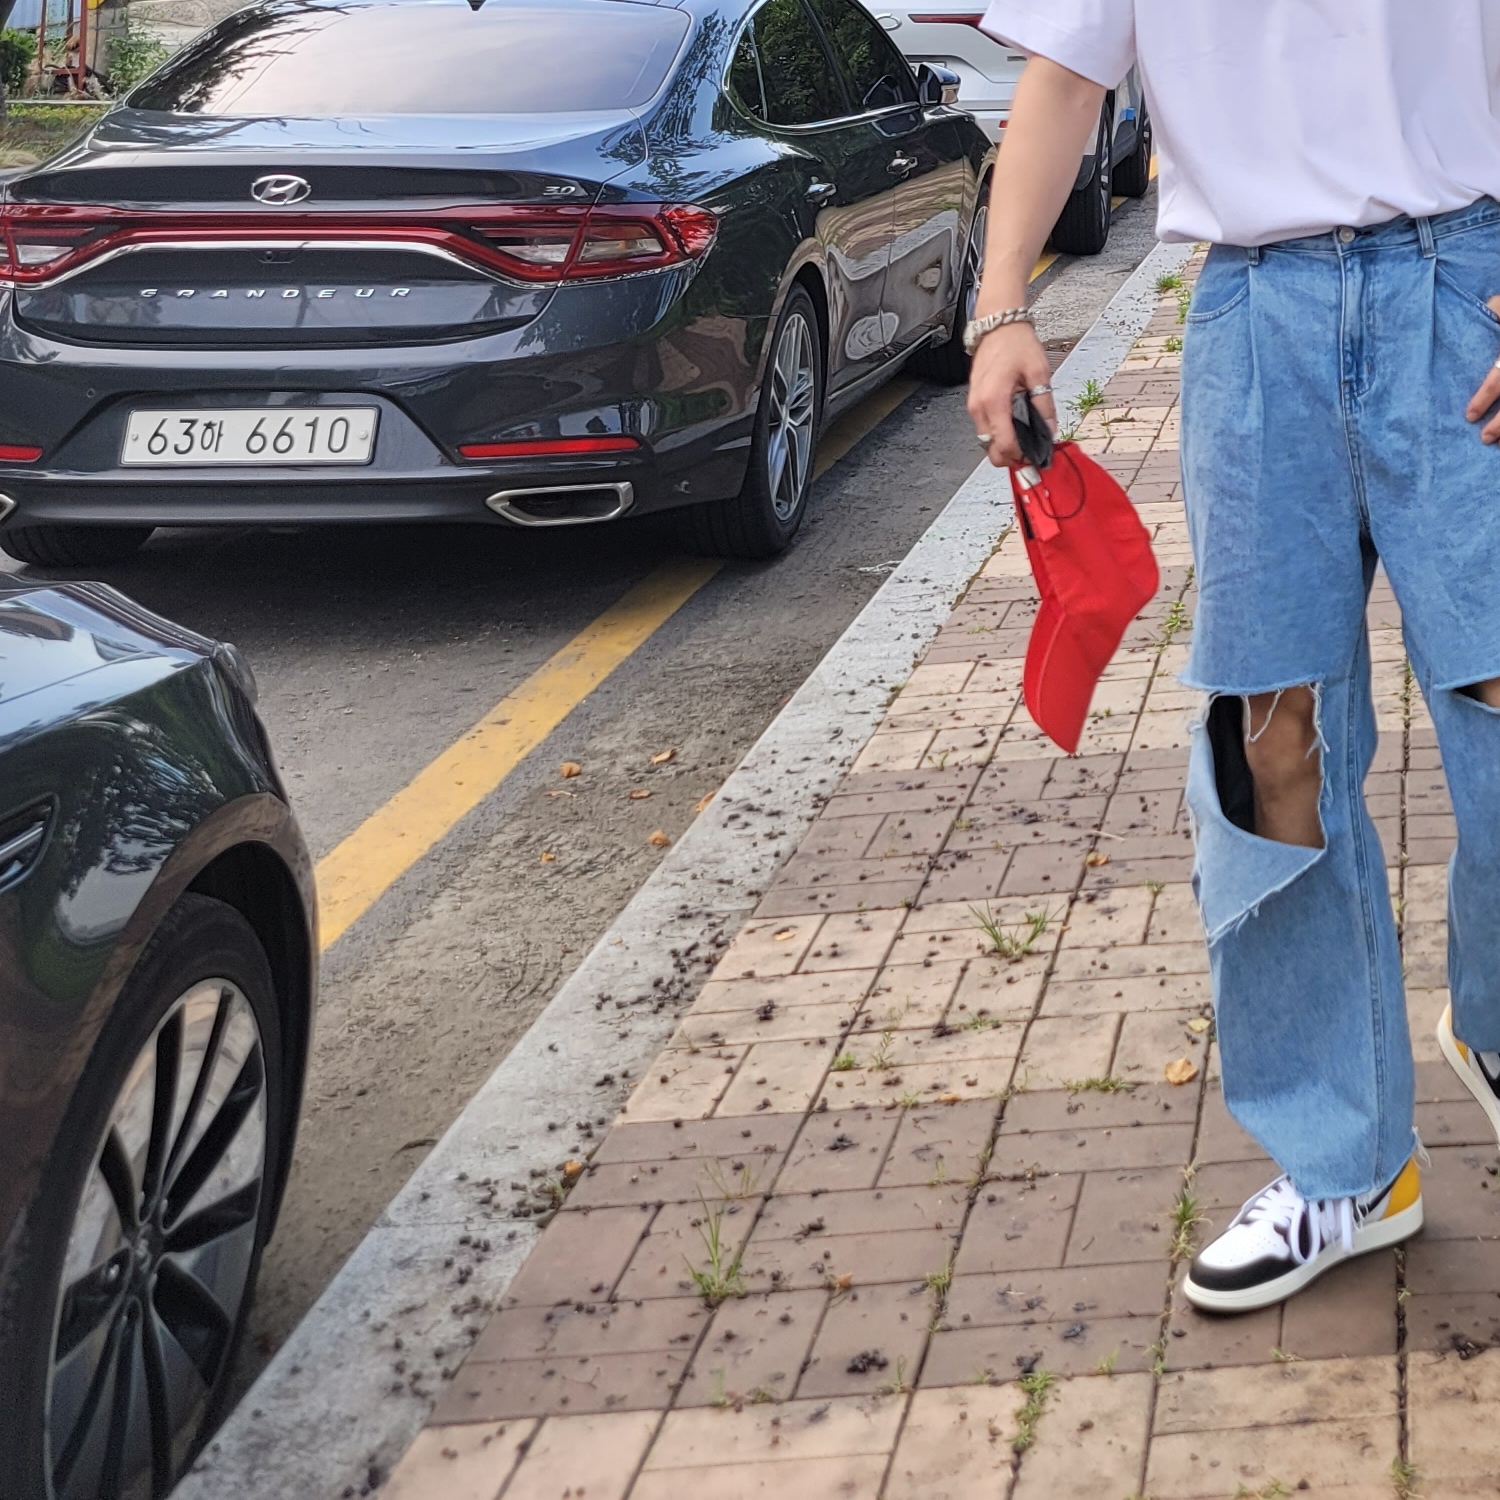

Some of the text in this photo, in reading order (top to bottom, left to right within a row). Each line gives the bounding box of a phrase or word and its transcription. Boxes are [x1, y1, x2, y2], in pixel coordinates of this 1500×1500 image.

[139, 287, 411, 299] GRANDEUR
[147, 416, 350, 456] 63하 6610
